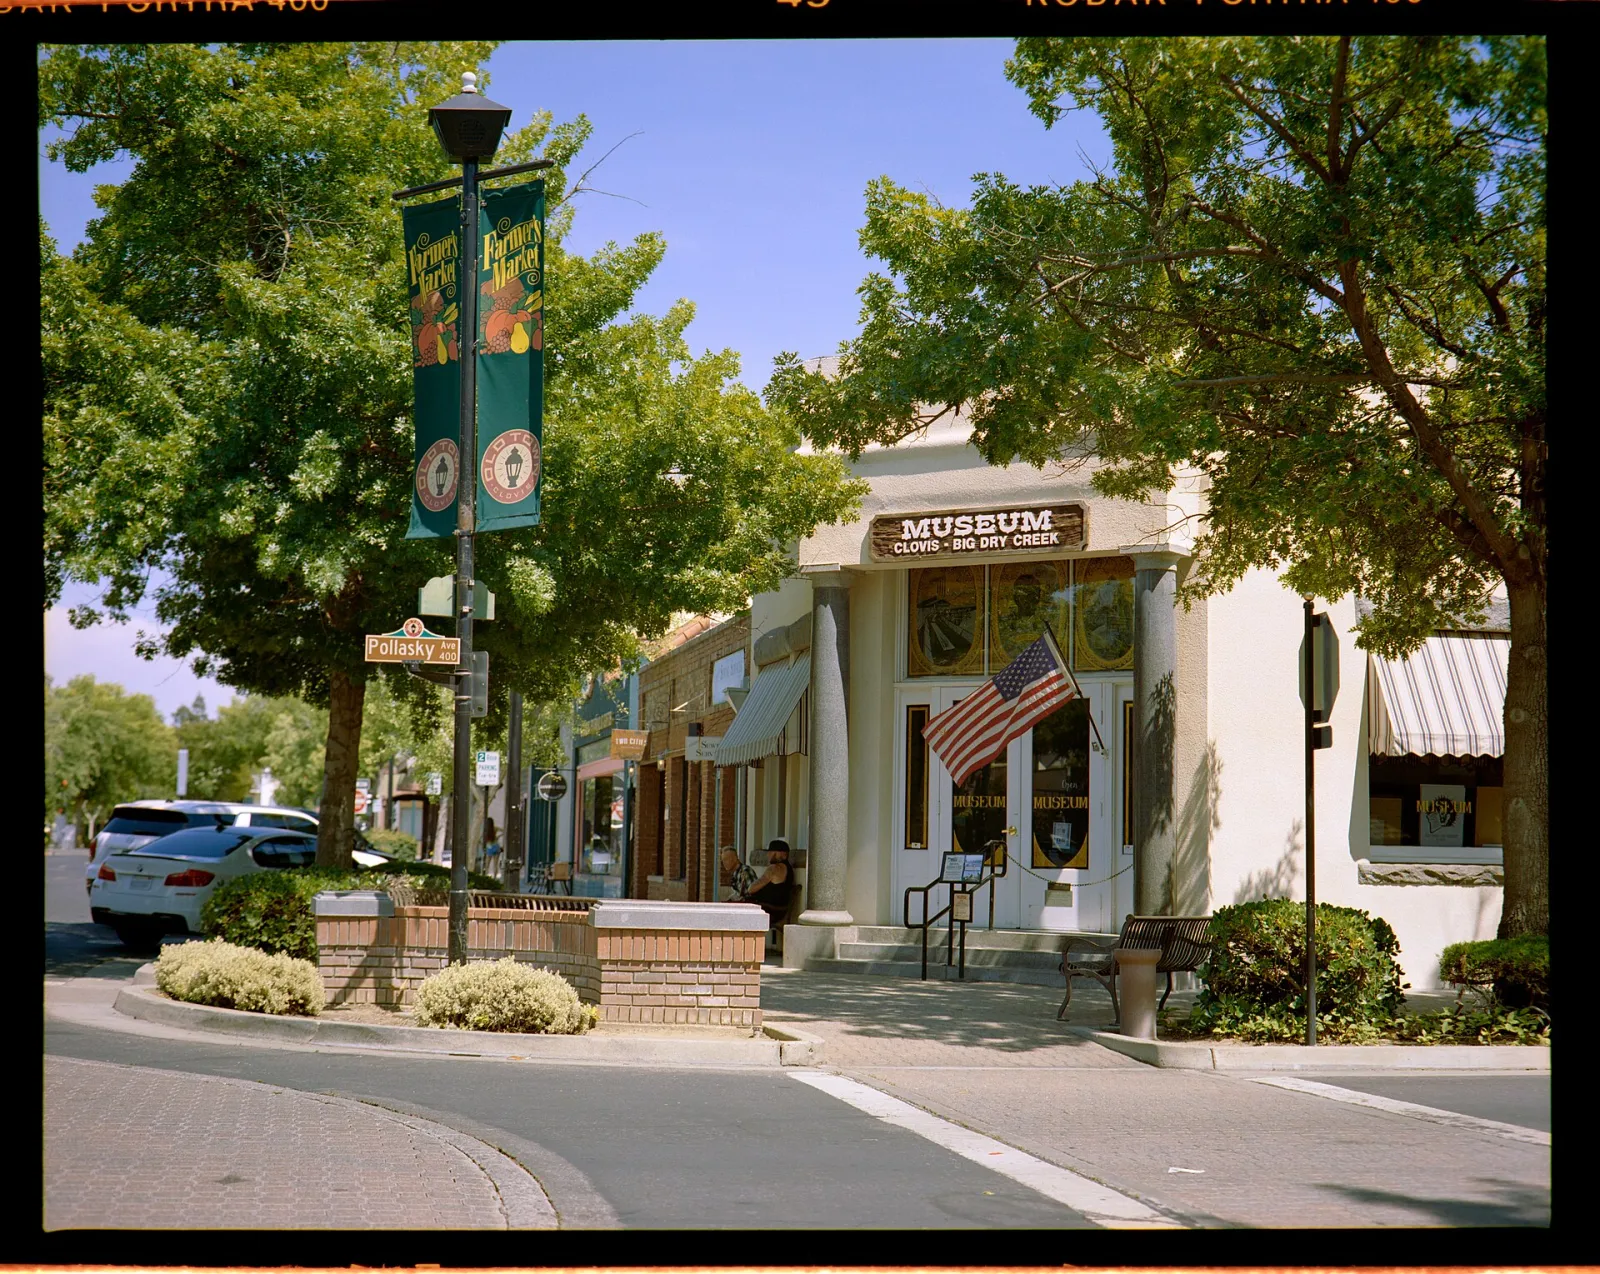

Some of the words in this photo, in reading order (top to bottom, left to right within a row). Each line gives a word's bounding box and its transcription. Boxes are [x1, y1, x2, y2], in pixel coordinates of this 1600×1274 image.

[491, 243, 541, 294] Market
[418, 257, 457, 308] Market
[484, 438, 506, 482] OLD
[509, 432, 540, 477] TOWN
[416, 448, 437, 490] OLD
[901, 509, 1053, 541] MUSEUM
[894, 539, 940, 555] CLOVIS
[952, 537, 976, 551] BIG
[979, 535, 1008, 549] DRY
[1012, 532, 1060, 547] CREEK
[368, 638, 435, 660] Pollasky
[440, 641, 456, 650] Ave
[439, 652, 457, 661] 400
[479, 753, 485, 761] 2
[953, 795, 1006, 808] MUSEUM
[1033, 796, 1089, 809] MUSEUM
[1416, 799, 1472, 814] MUSEUM
